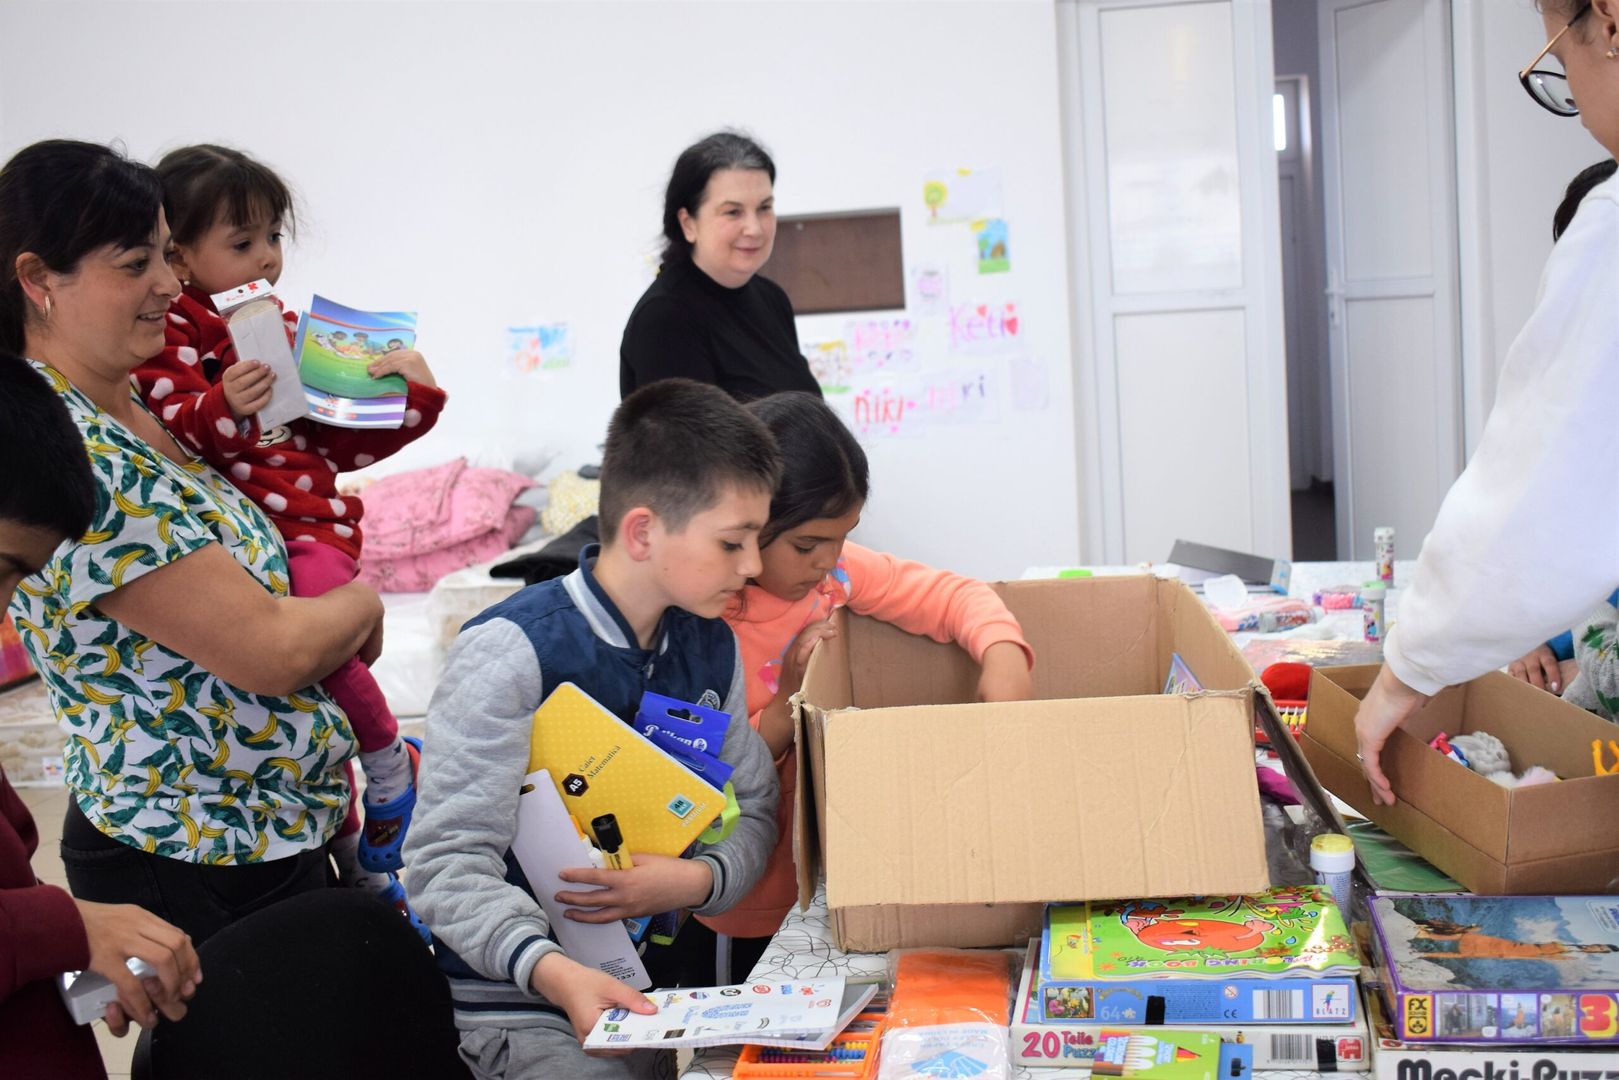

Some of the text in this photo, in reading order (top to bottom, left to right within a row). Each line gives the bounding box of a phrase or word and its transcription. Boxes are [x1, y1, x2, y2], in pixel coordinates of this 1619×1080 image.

[569, 778, 583, 793] A5
[1408, 997, 1427, 1011] FX
[1102, 1006, 1121, 1020] 64
[1021, 1031, 1060, 1058] 20
[1061, 1031, 1093, 1045] Teile
[1063, 1044, 1097, 1058] Puzz
